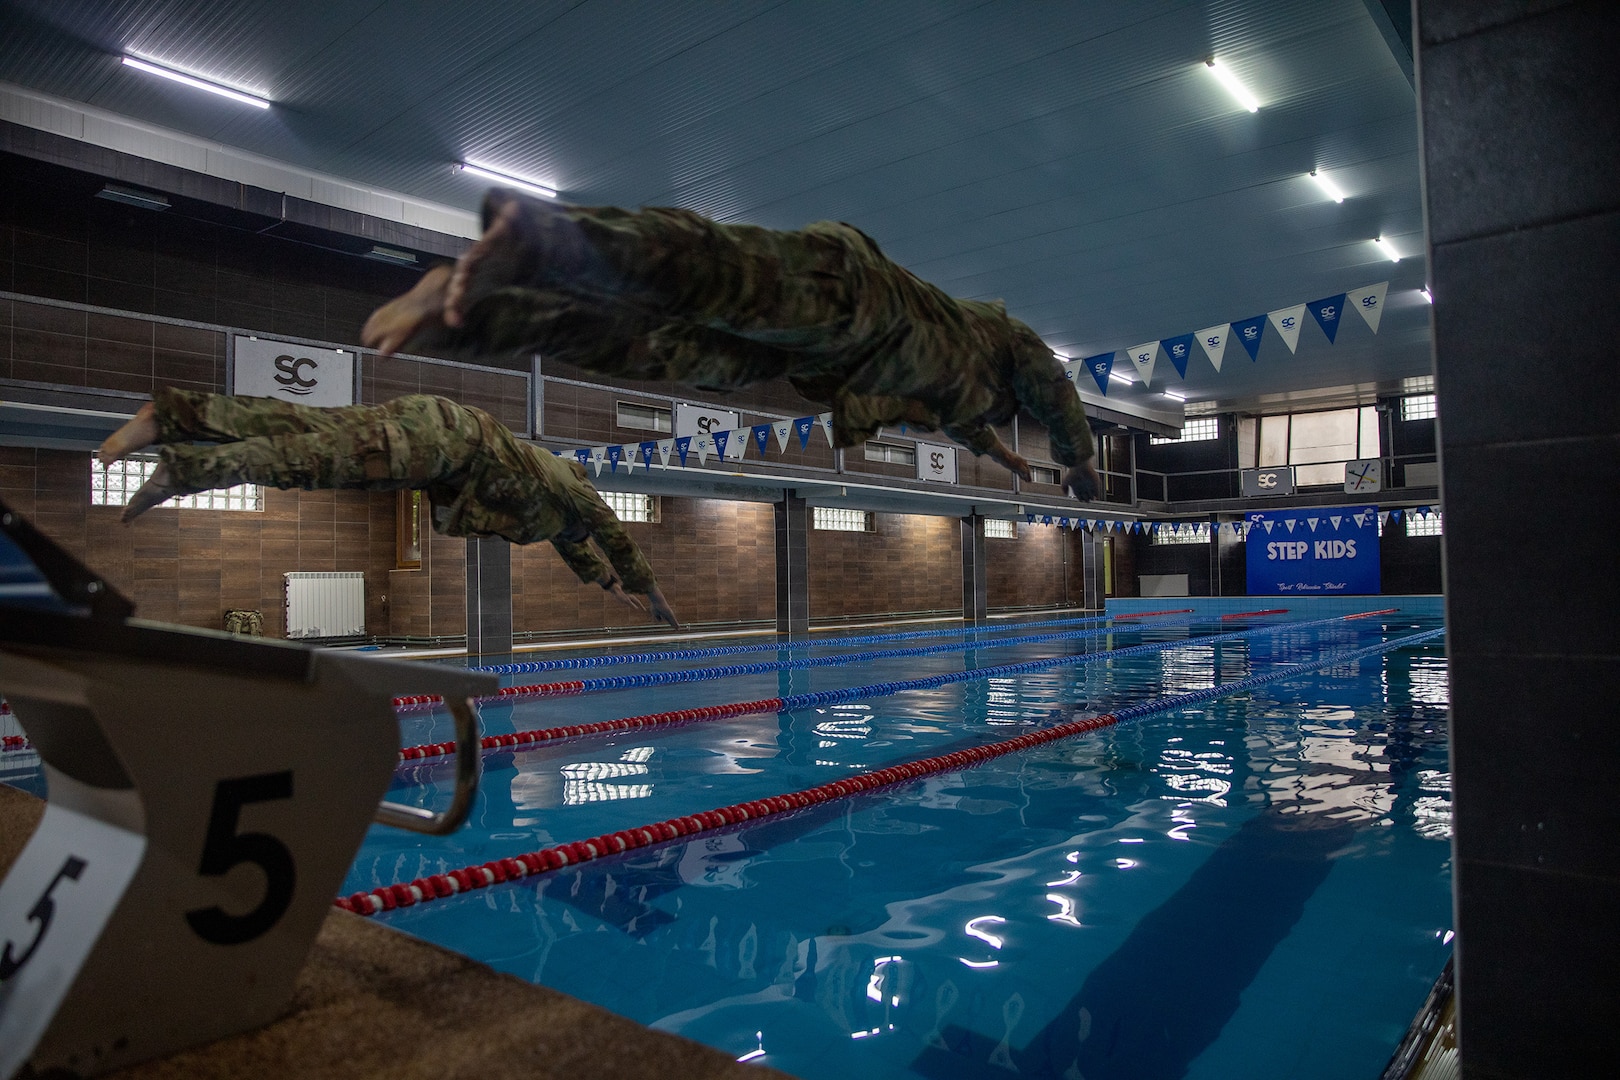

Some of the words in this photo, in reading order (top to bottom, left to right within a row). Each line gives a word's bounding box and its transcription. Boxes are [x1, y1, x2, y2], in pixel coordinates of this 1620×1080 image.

[1362, 295, 1377, 307] SC
[1321, 306, 1336, 318] SC
[1282, 317, 1295, 328] SC
[1244, 326, 1258, 337] SC
[1207, 336, 1220, 346] SC
[1172, 344, 1185, 354] SC
[1138, 353, 1150, 363] SC
[273, 354, 318, 388] SC
[1095, 362, 1107, 373] SC
[930, 452, 945, 470] SC
[1258, 473, 1278, 488] SC
[1266, 541, 1309, 561] STEP
[1314, 539, 1357, 560] KIDS
[185, 769, 296, 946] 5
[0, 854, 89, 980] 5
